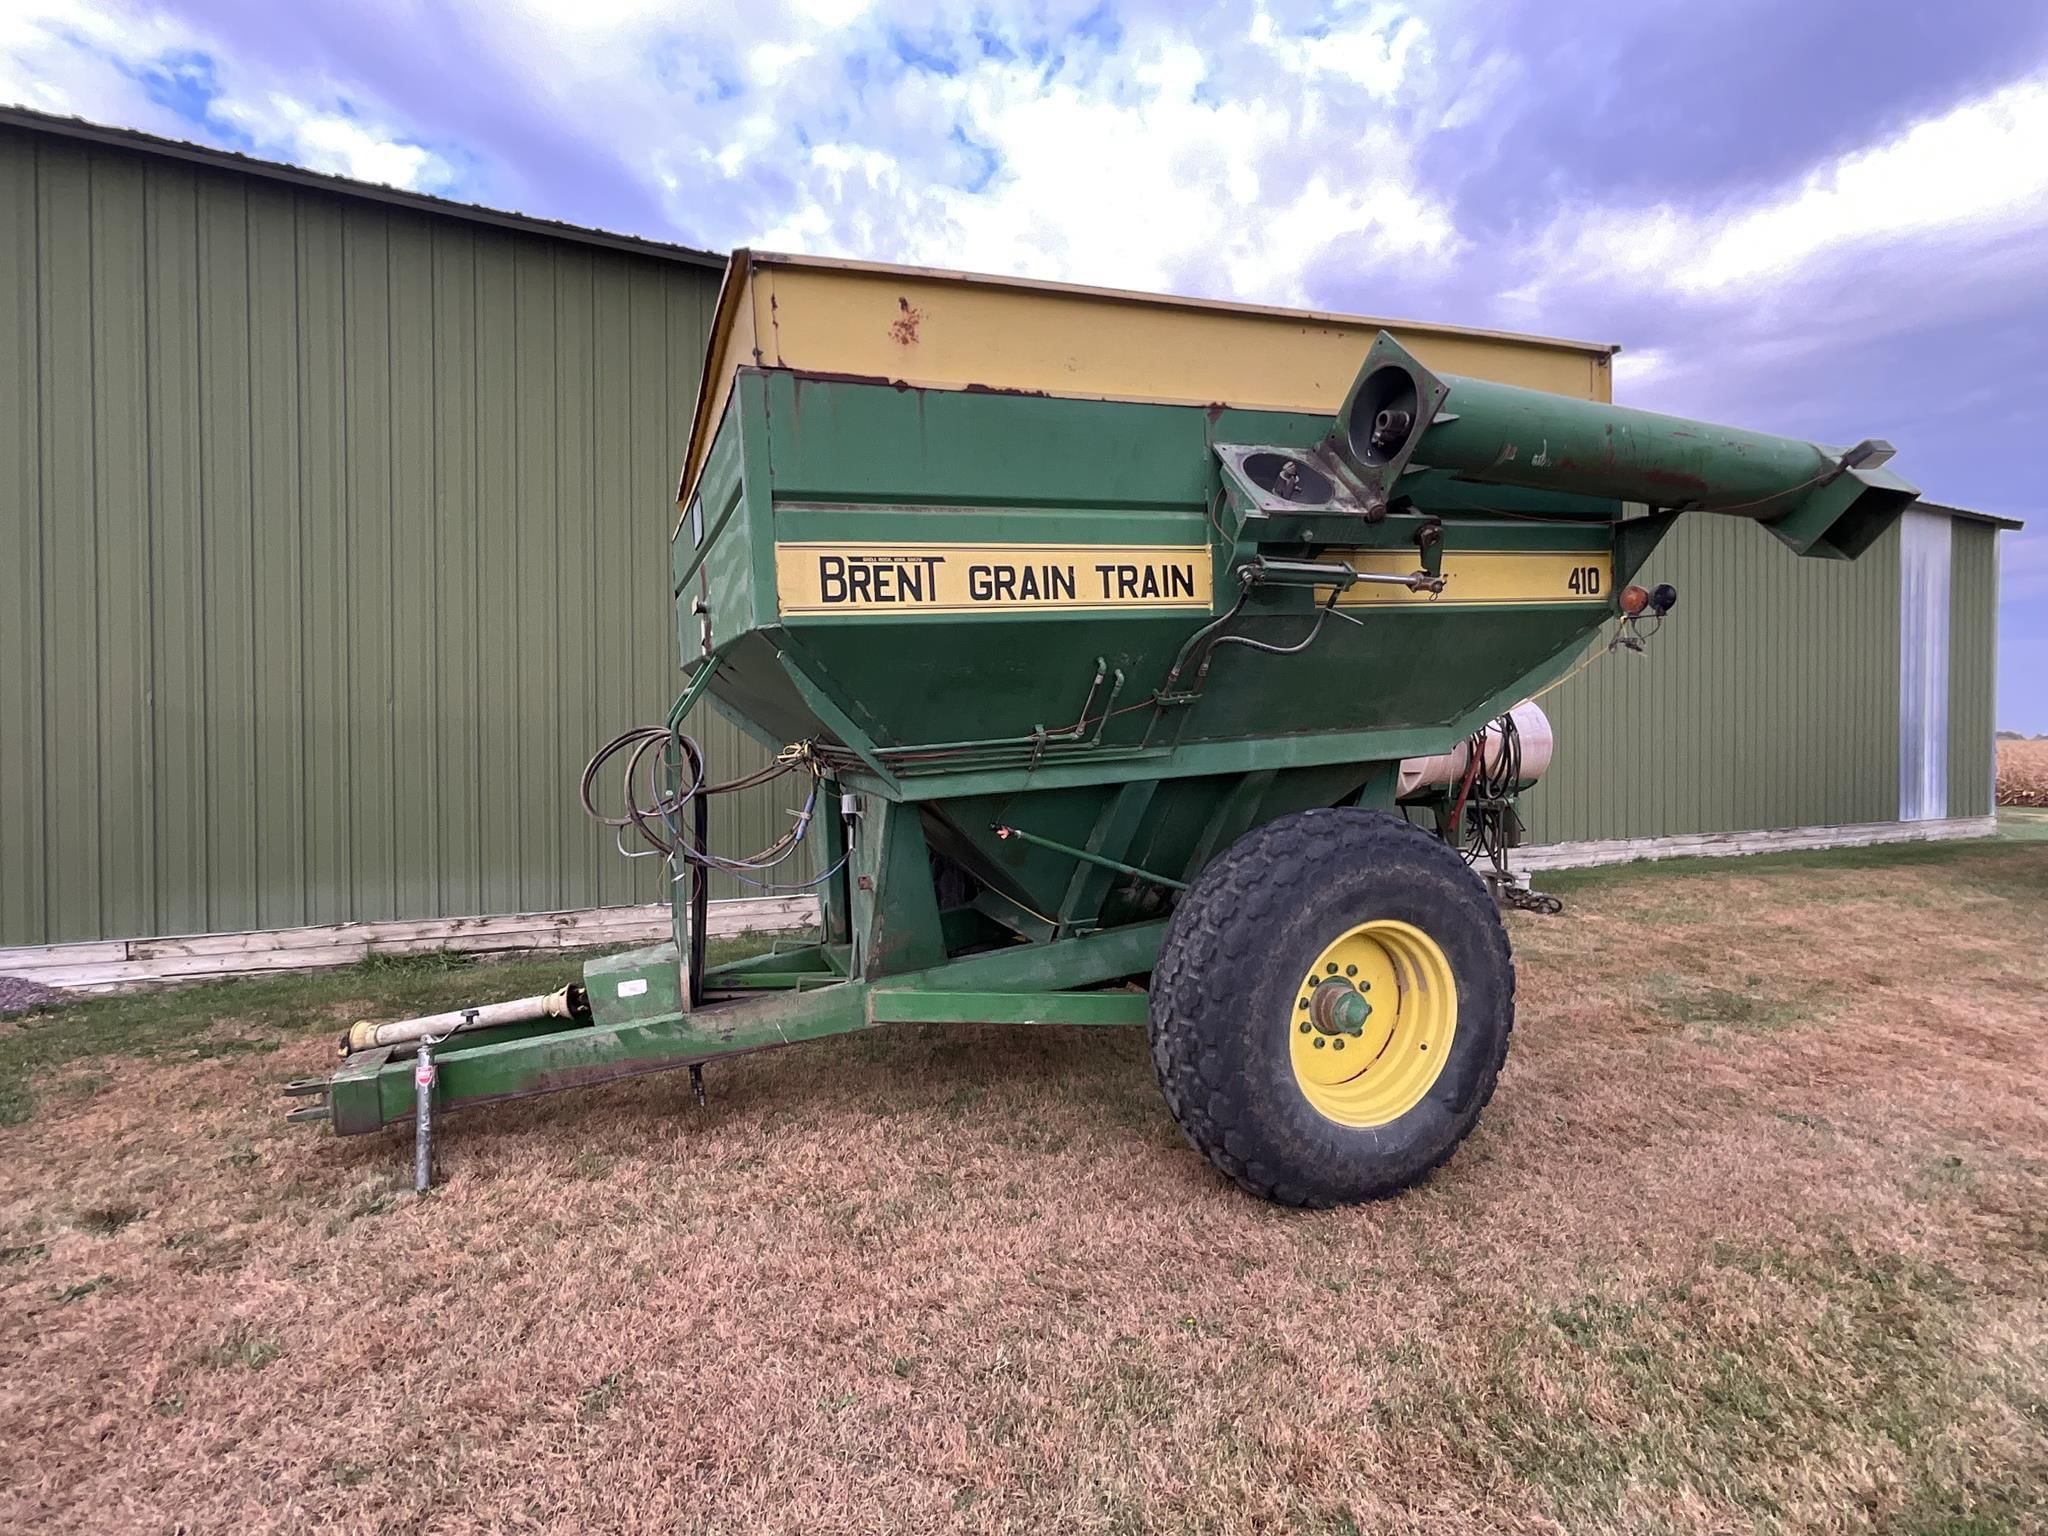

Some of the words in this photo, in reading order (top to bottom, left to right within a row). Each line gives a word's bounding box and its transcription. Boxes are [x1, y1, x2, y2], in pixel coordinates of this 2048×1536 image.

[819, 556, 945, 602] BRENT
[968, 565, 1076, 600] GRAIN
[1095, 564, 1194, 598] TRAIN
[1568, 567, 1600, 595] 410
